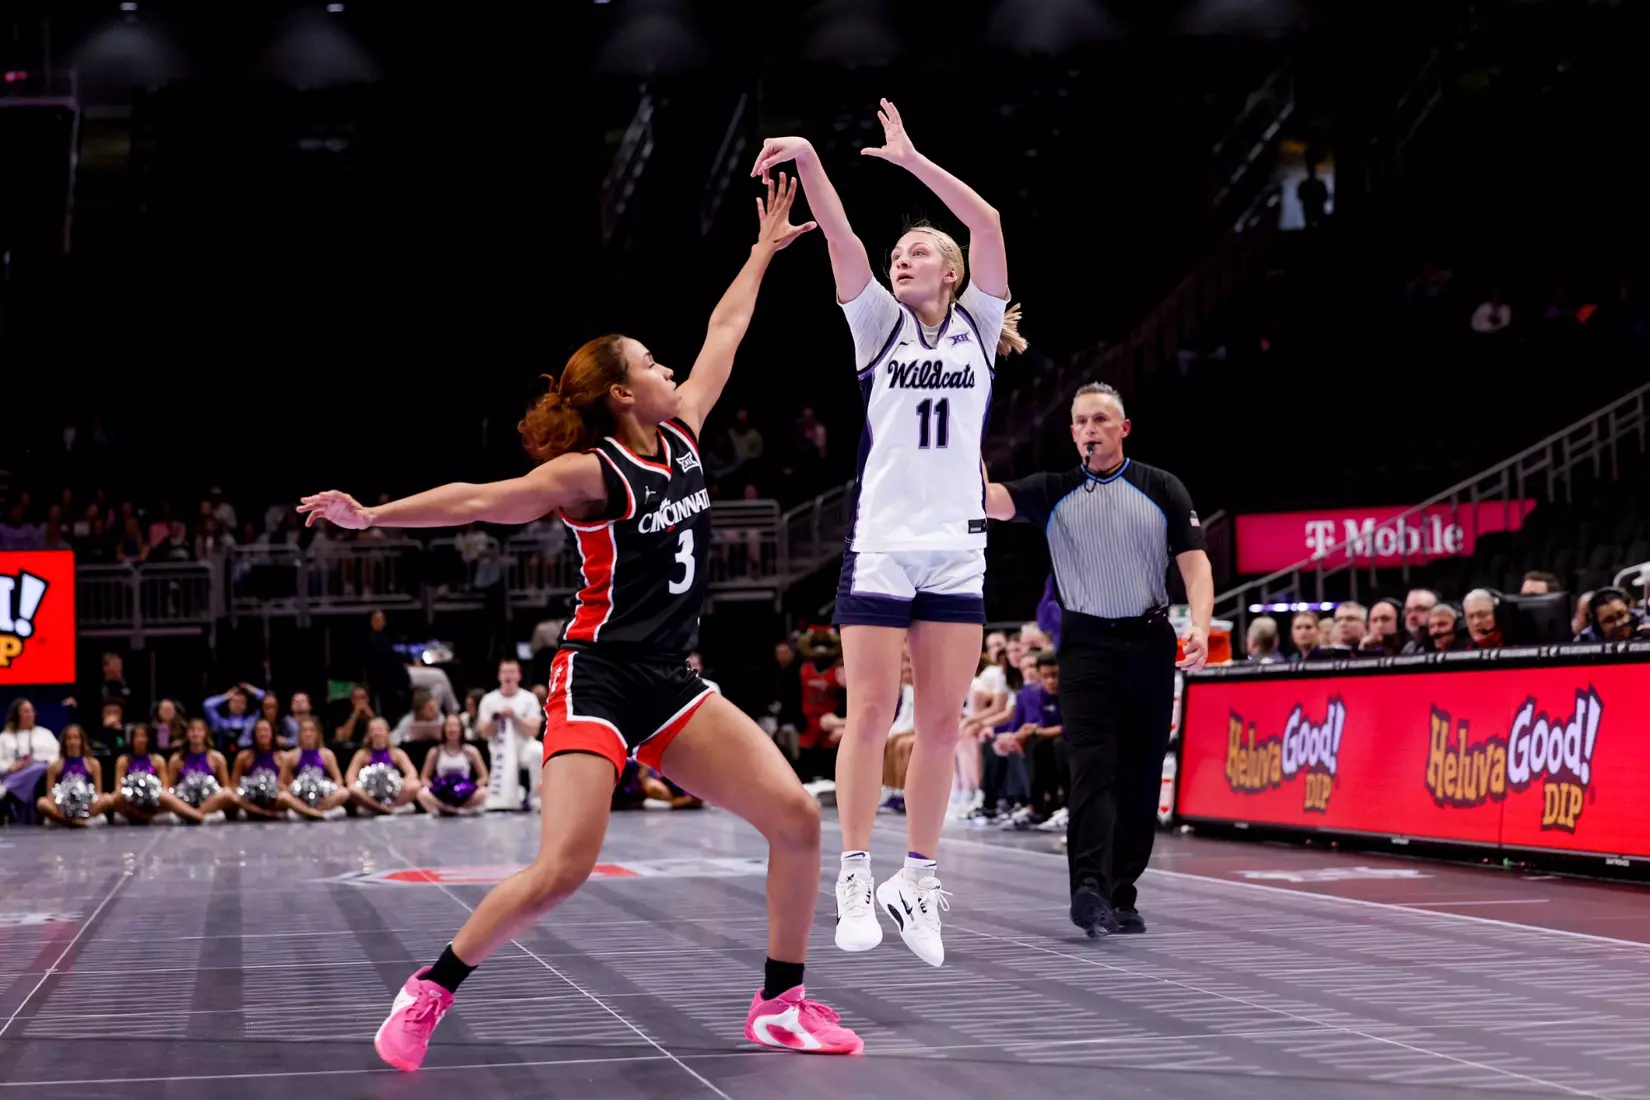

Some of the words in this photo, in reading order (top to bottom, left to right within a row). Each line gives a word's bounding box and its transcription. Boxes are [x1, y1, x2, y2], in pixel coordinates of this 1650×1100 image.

[887, 359, 976, 389] Wildcats
[916, 397, 950, 449] 11
[668, 528, 696, 595] 3
[1225, 714, 1281, 789] Heluva
[1281, 698, 1347, 777] Good!
[1425, 710, 1507, 803] Heluva
[1507, 692, 1602, 787] Good!
[1303, 772, 1332, 811] DIP
[1541, 781, 1584, 830] DIP
